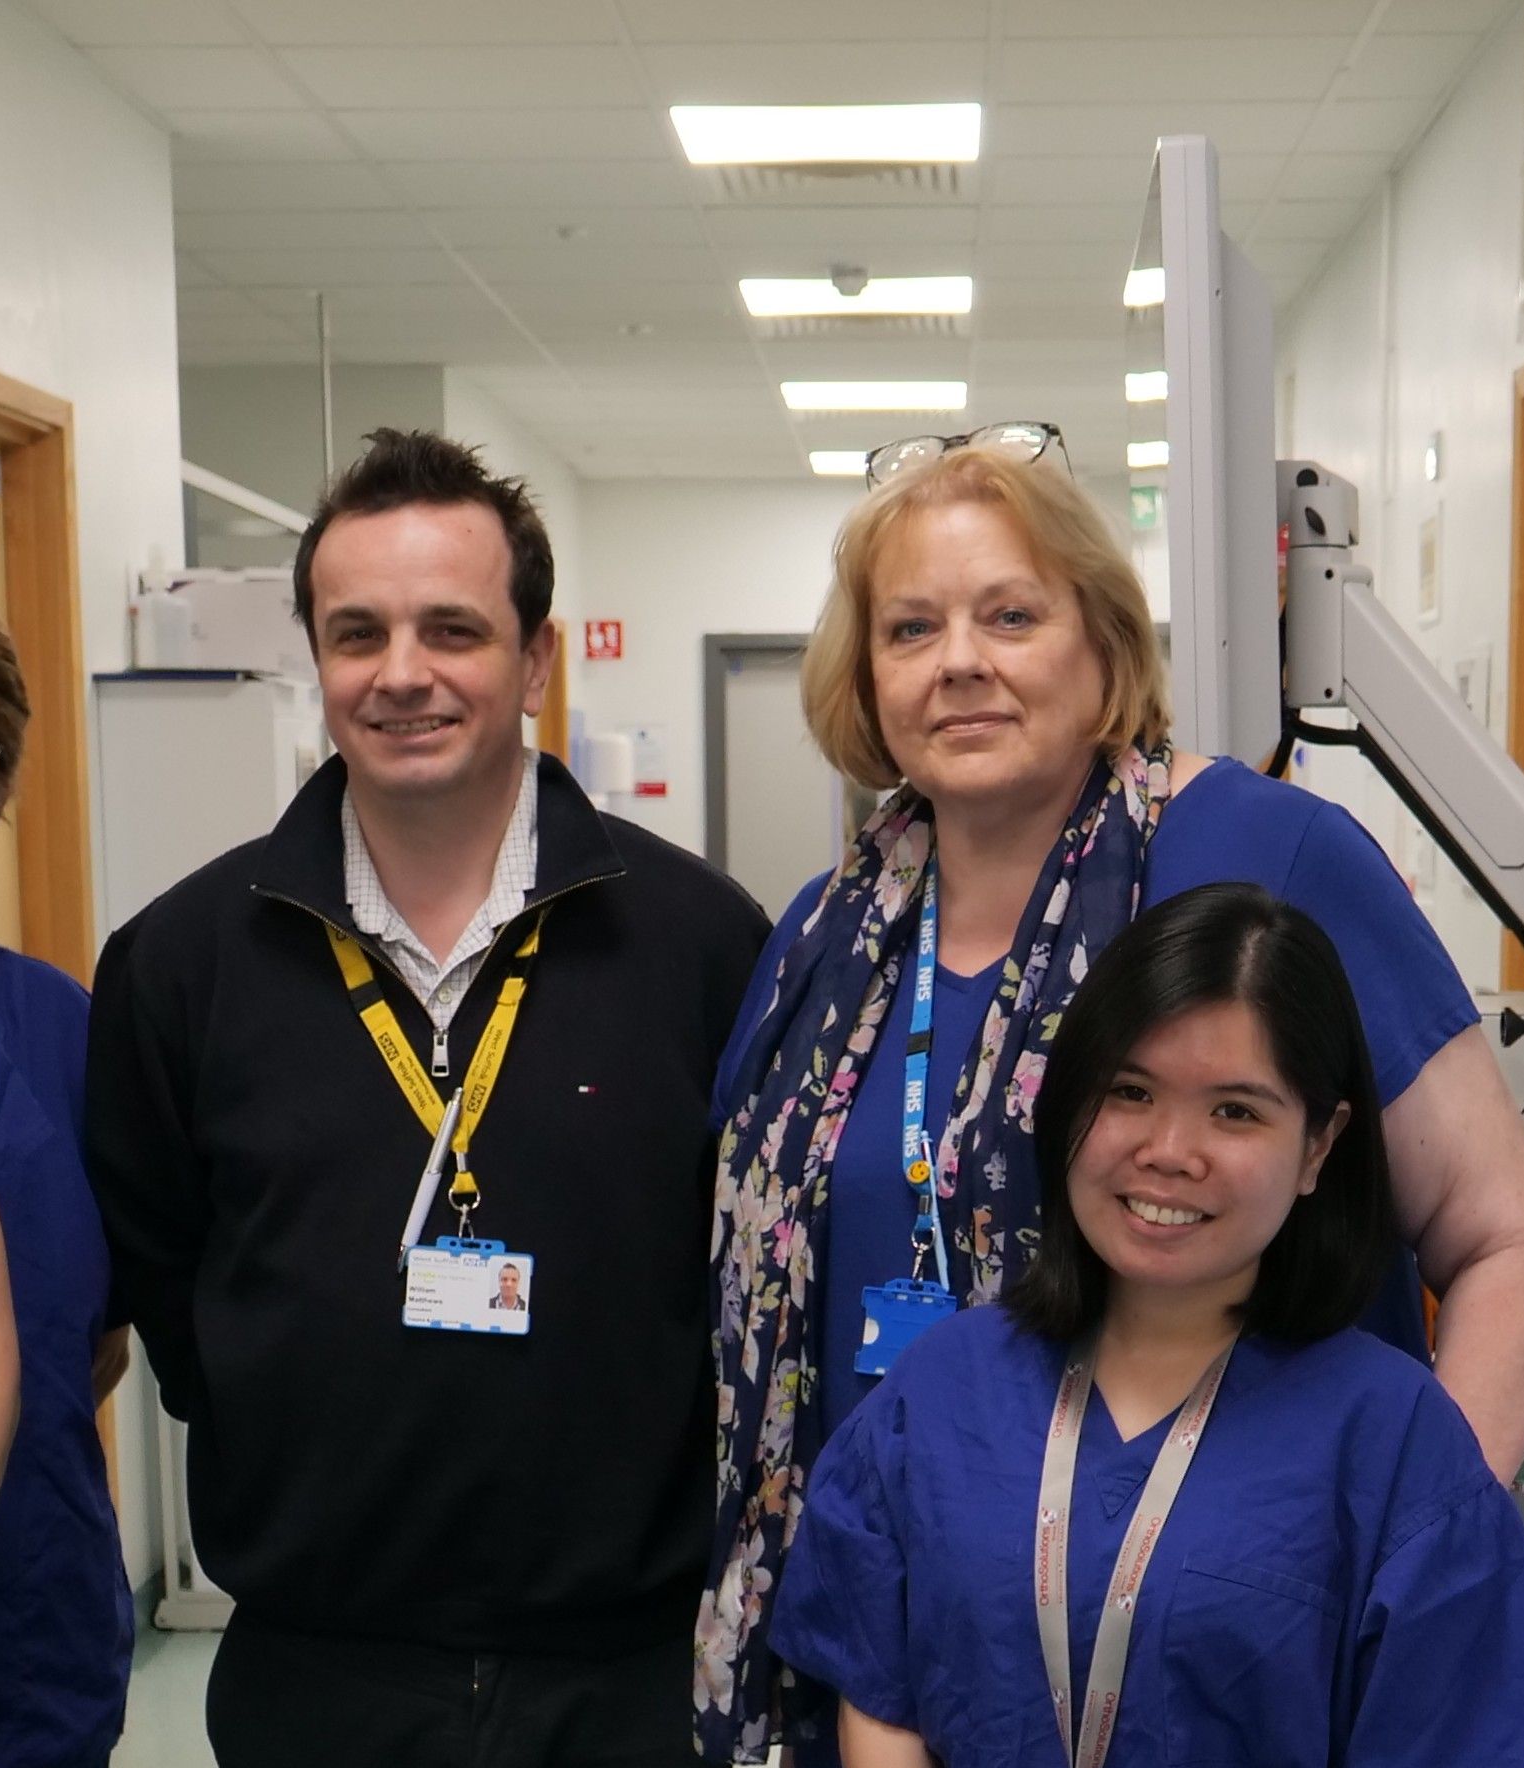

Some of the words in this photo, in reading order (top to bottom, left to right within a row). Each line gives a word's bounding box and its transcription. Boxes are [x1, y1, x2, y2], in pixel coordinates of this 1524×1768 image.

[923, 872, 935, 909] NHS
[920, 918, 935, 956] NHS
[917, 965, 932, 1003] NHS
[377, 1031, 400, 1063] NHS
[467, 1083, 487, 1114] NHS
[906, 1079, 923, 1113] NHS
[903, 1123, 920, 1158] NHS
[1039, 1526, 1050, 1606] OrthoSolutions
[1126, 1516, 1161, 1593] OrthoSolutions
